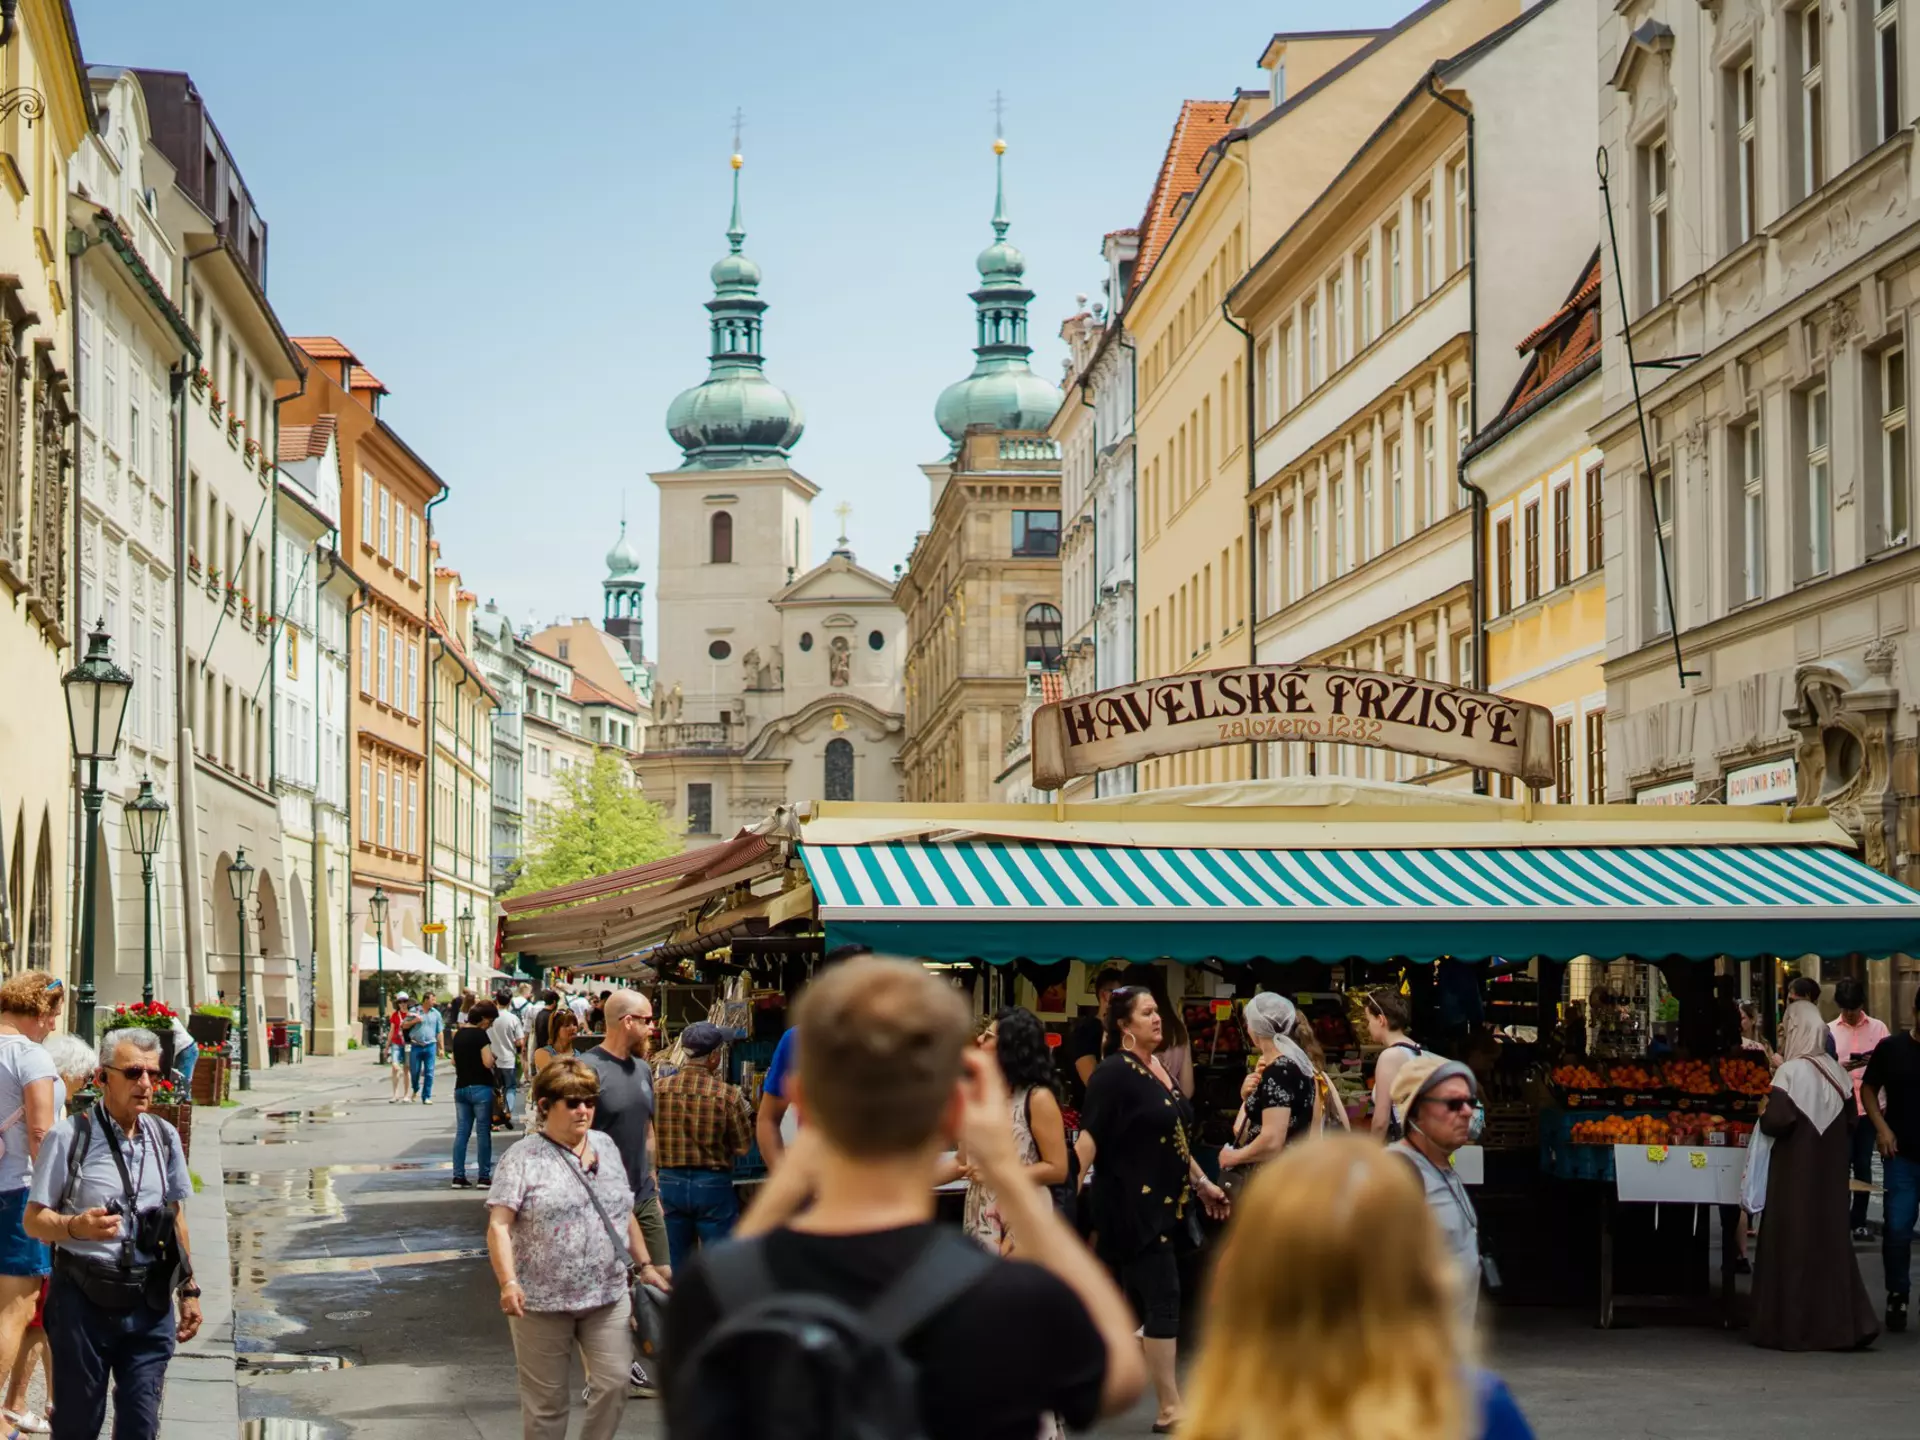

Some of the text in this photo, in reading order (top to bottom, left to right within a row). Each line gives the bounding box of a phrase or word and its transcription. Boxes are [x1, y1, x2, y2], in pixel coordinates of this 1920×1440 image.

[1062, 667, 1520, 747] HAVELSKÉ TRŽIŠTĚ
[1218, 715, 1383, 742] založeno 1232
[1730, 767, 1792, 797] SOUVENIR SHOP
